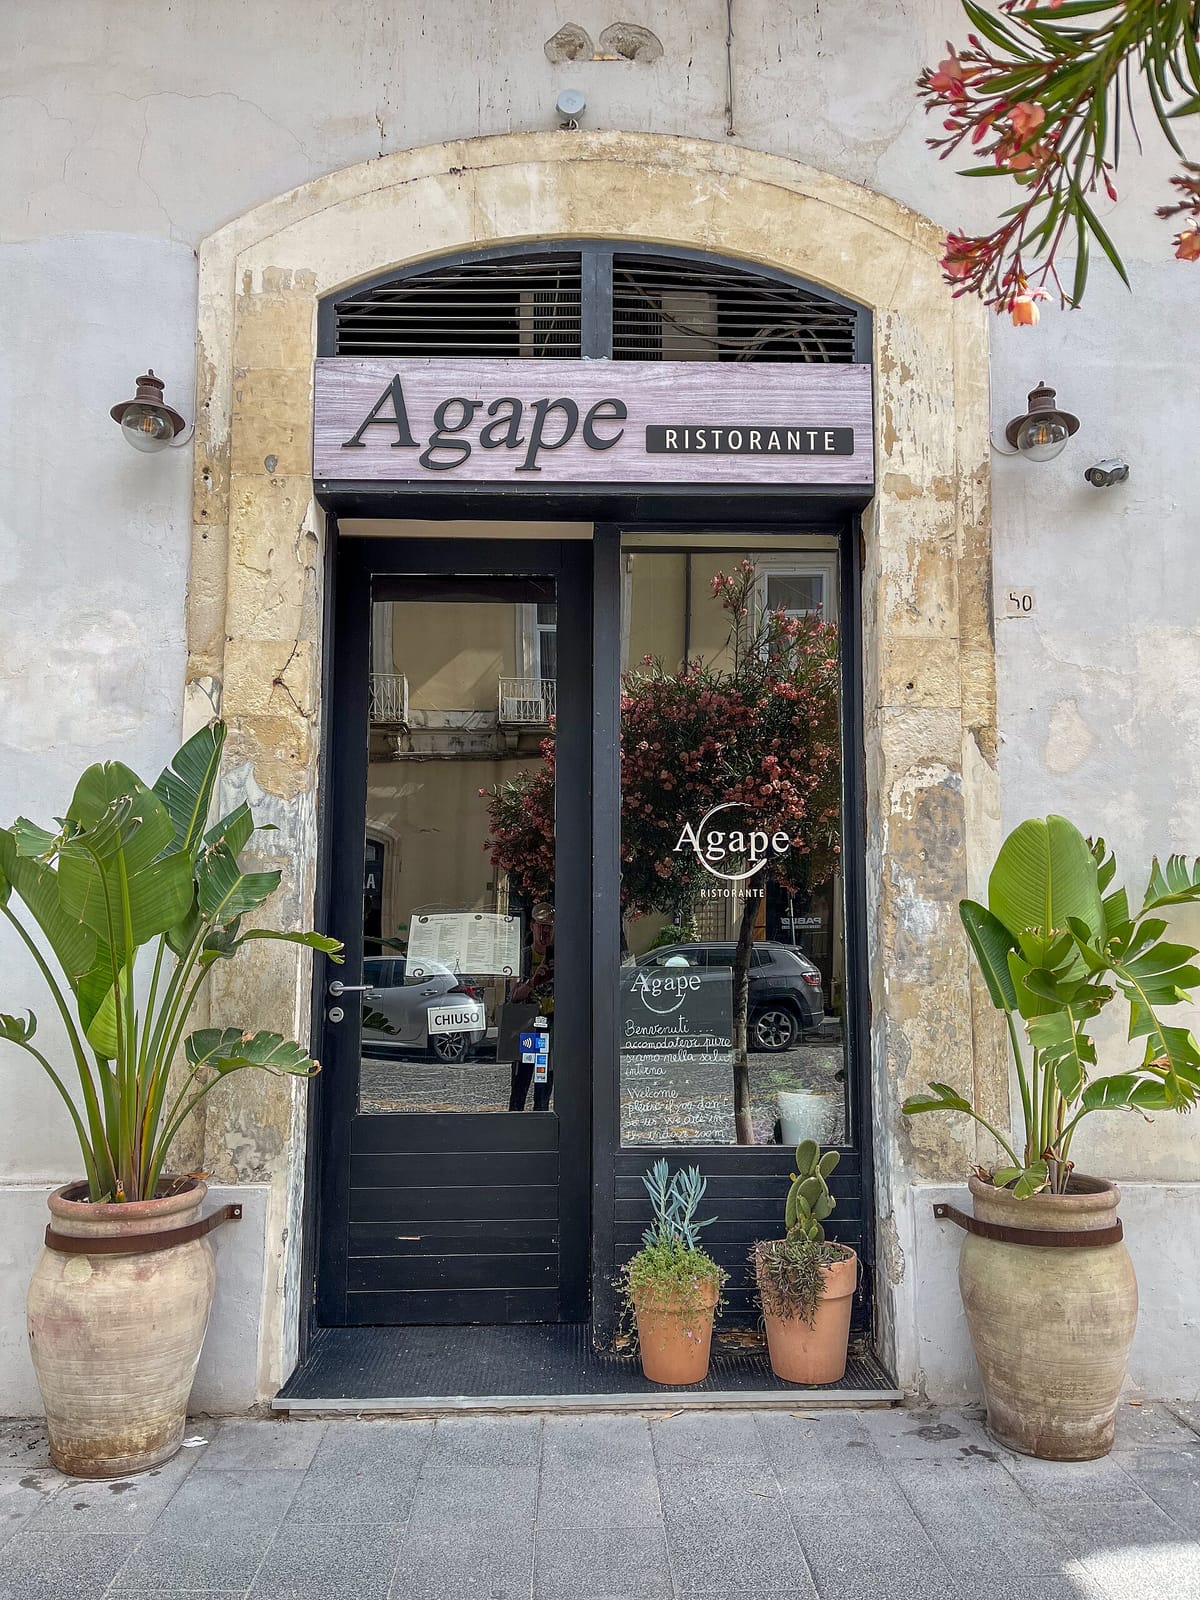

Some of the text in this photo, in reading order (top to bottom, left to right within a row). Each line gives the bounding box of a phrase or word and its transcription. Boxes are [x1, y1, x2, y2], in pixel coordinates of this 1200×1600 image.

[341, 372, 837, 472] Agape RISTORANTE
[672, 821, 790, 861] Agape
[700, 888, 765, 898] RISTORANTE
[630, 972, 701, 998] Agape
[434, 1012, 480, 1026] CHIUSO
[703, 1037, 733, 1053] pure
[663, 1049, 696, 1063] nella
[627, 1086, 679, 1099] Welcome
